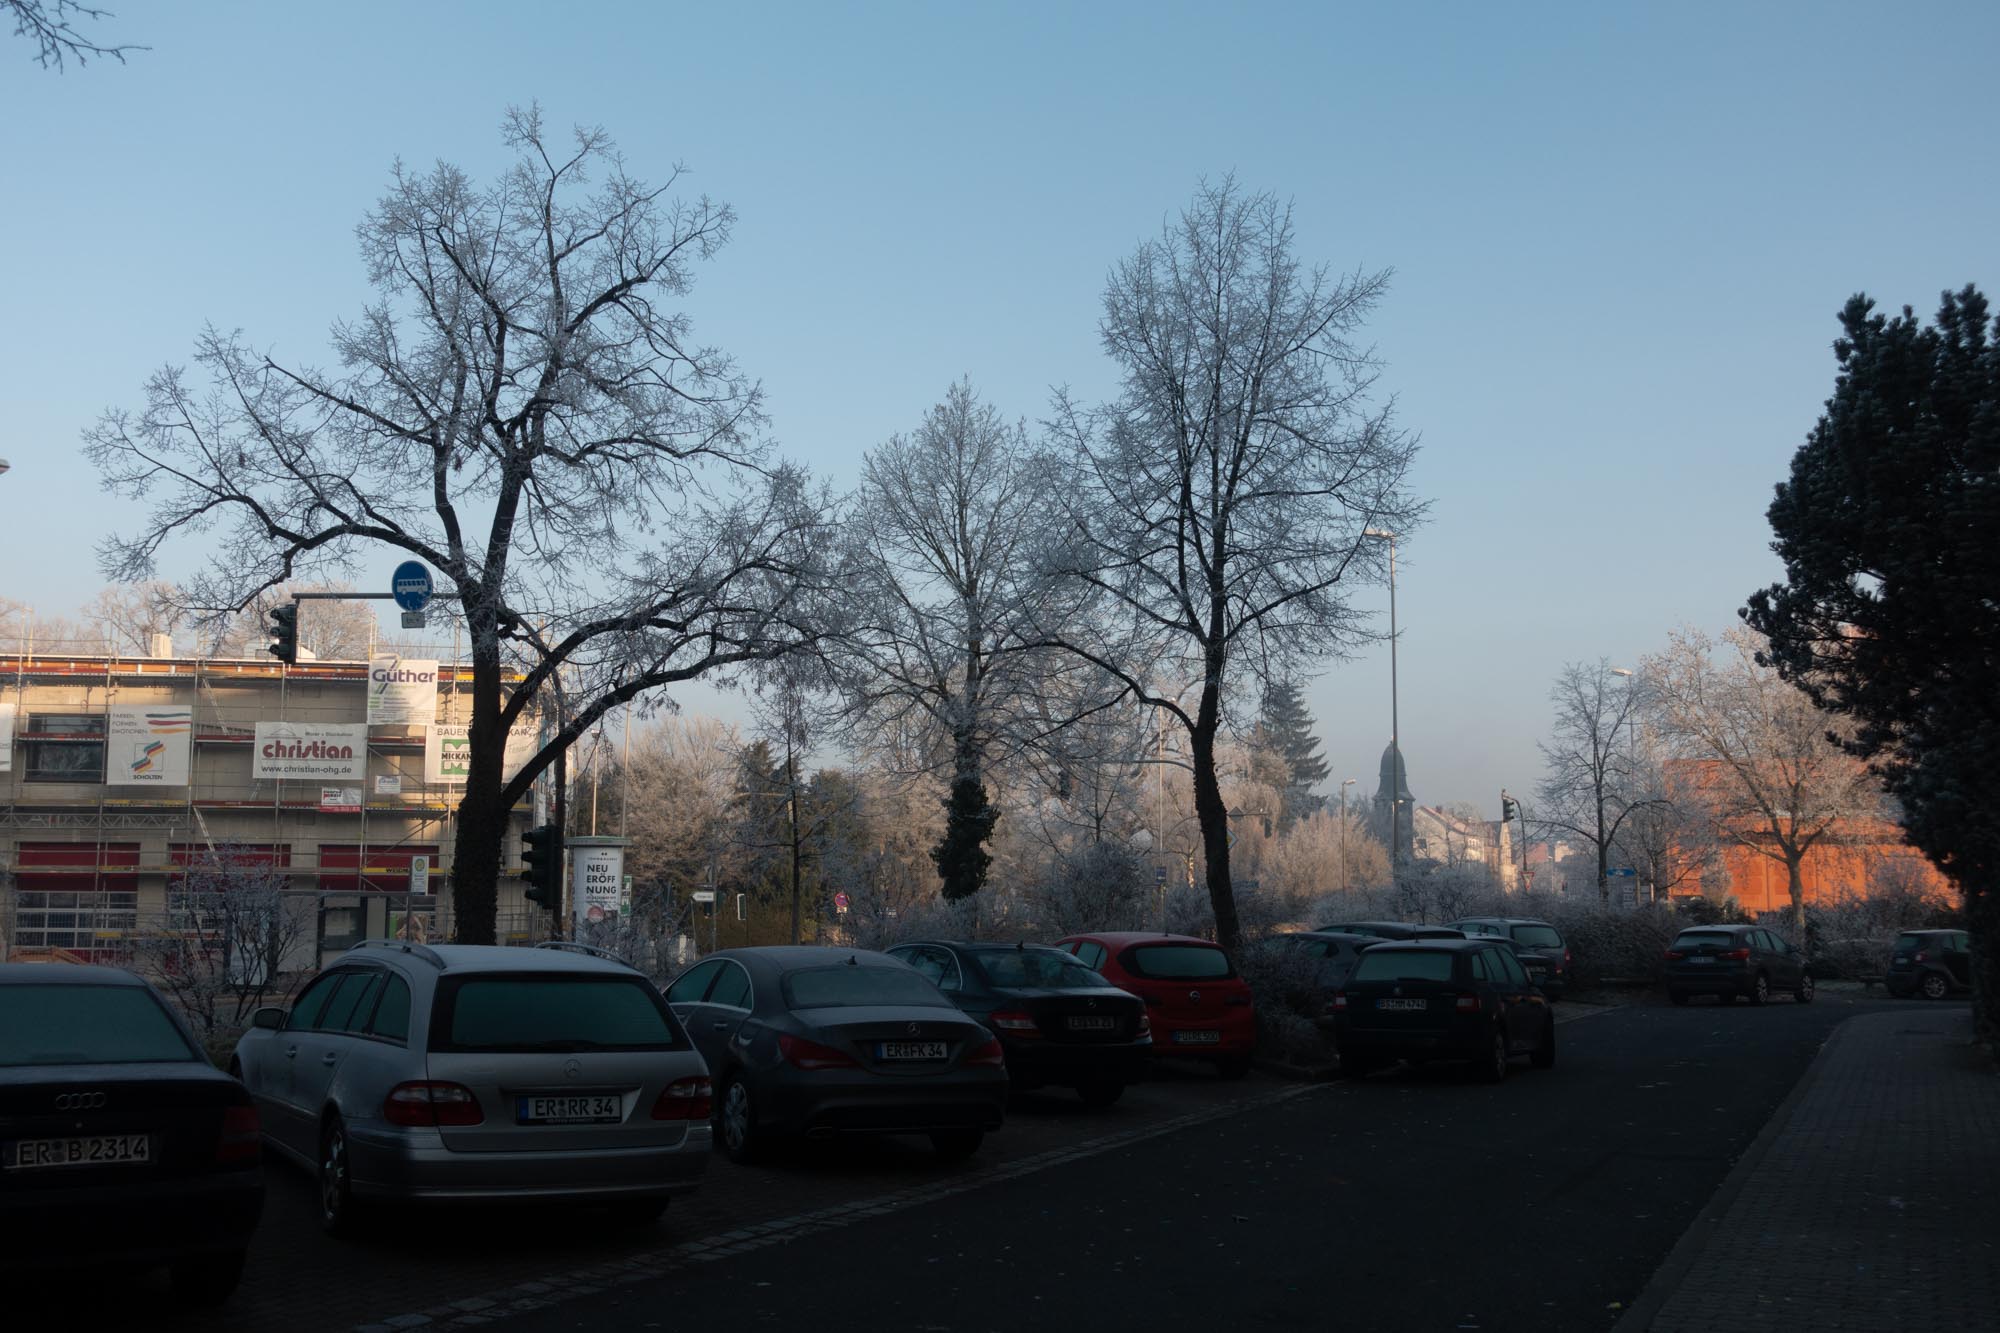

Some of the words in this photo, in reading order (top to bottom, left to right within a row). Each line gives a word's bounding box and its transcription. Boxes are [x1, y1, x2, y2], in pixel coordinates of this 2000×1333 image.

[372, 668, 436, 683] Güther
[262, 740, 352, 759] christian
[261, 766, 352, 775] www.christian-ohg.de
[587, 864, 608, 873] NEU
[586, 873, 616, 883] ERÖFF
[586, 885, 617, 894] NUNG
[886, 1042, 903, 1057] ER
[911, 1042, 926, 1057] FK
[928, 1042, 943, 1057] 34
[535, 1099, 556, 1116] ER
[568, 1099, 590, 1116] RR
[594, 1098, 614, 1115] 34
[19, 1143, 50, 1165] ER
[66, 1140, 82, 1162] B
[89, 1137, 147, 1160] 2314
